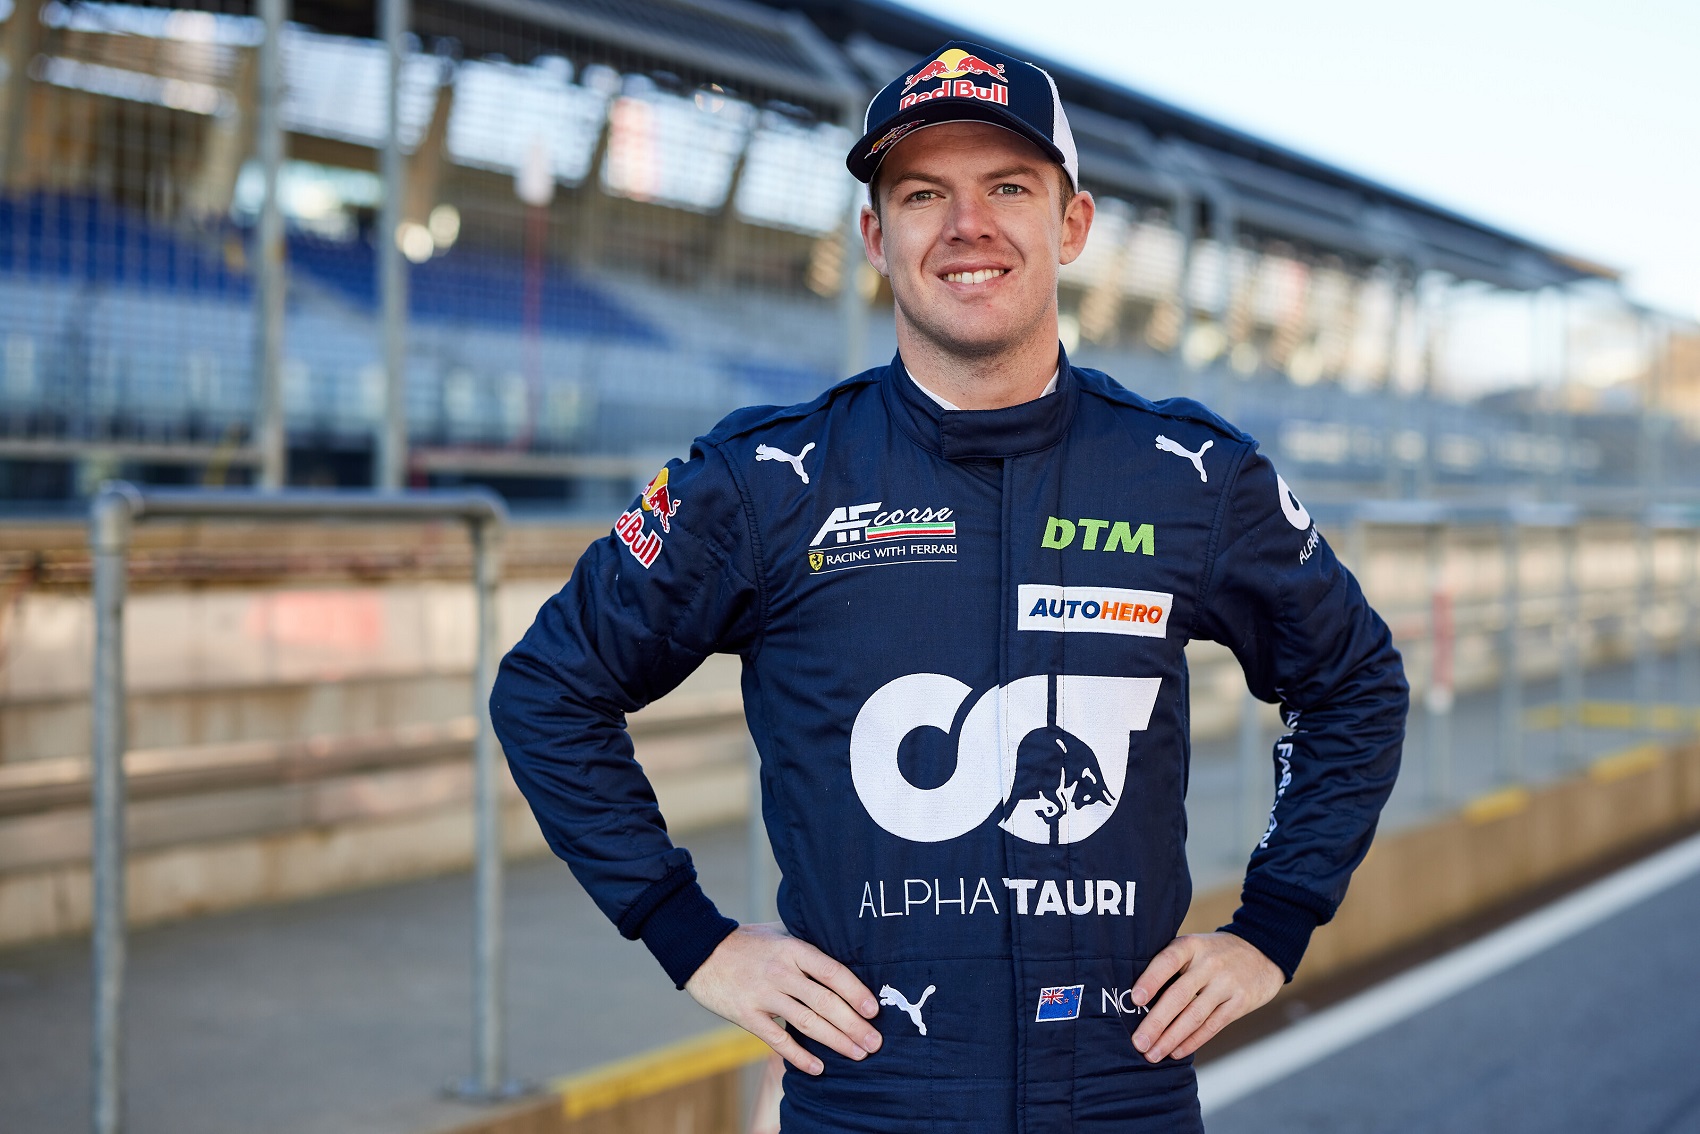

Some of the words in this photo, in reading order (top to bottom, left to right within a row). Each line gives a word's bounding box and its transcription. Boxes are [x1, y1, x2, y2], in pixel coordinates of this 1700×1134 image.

[899, 79, 951, 111] Red
[953, 79, 1009, 106] Bull
[873, 506, 954, 527] corse
[620, 514, 663, 569] Bull
[1040, 516, 1155, 556] DTM
[826, 550, 871, 566] RACING
[873, 545, 906, 558] WITH
[910, 544, 958, 555] FERRARI
[1028, 598, 1163, 625] AUTOHERO
